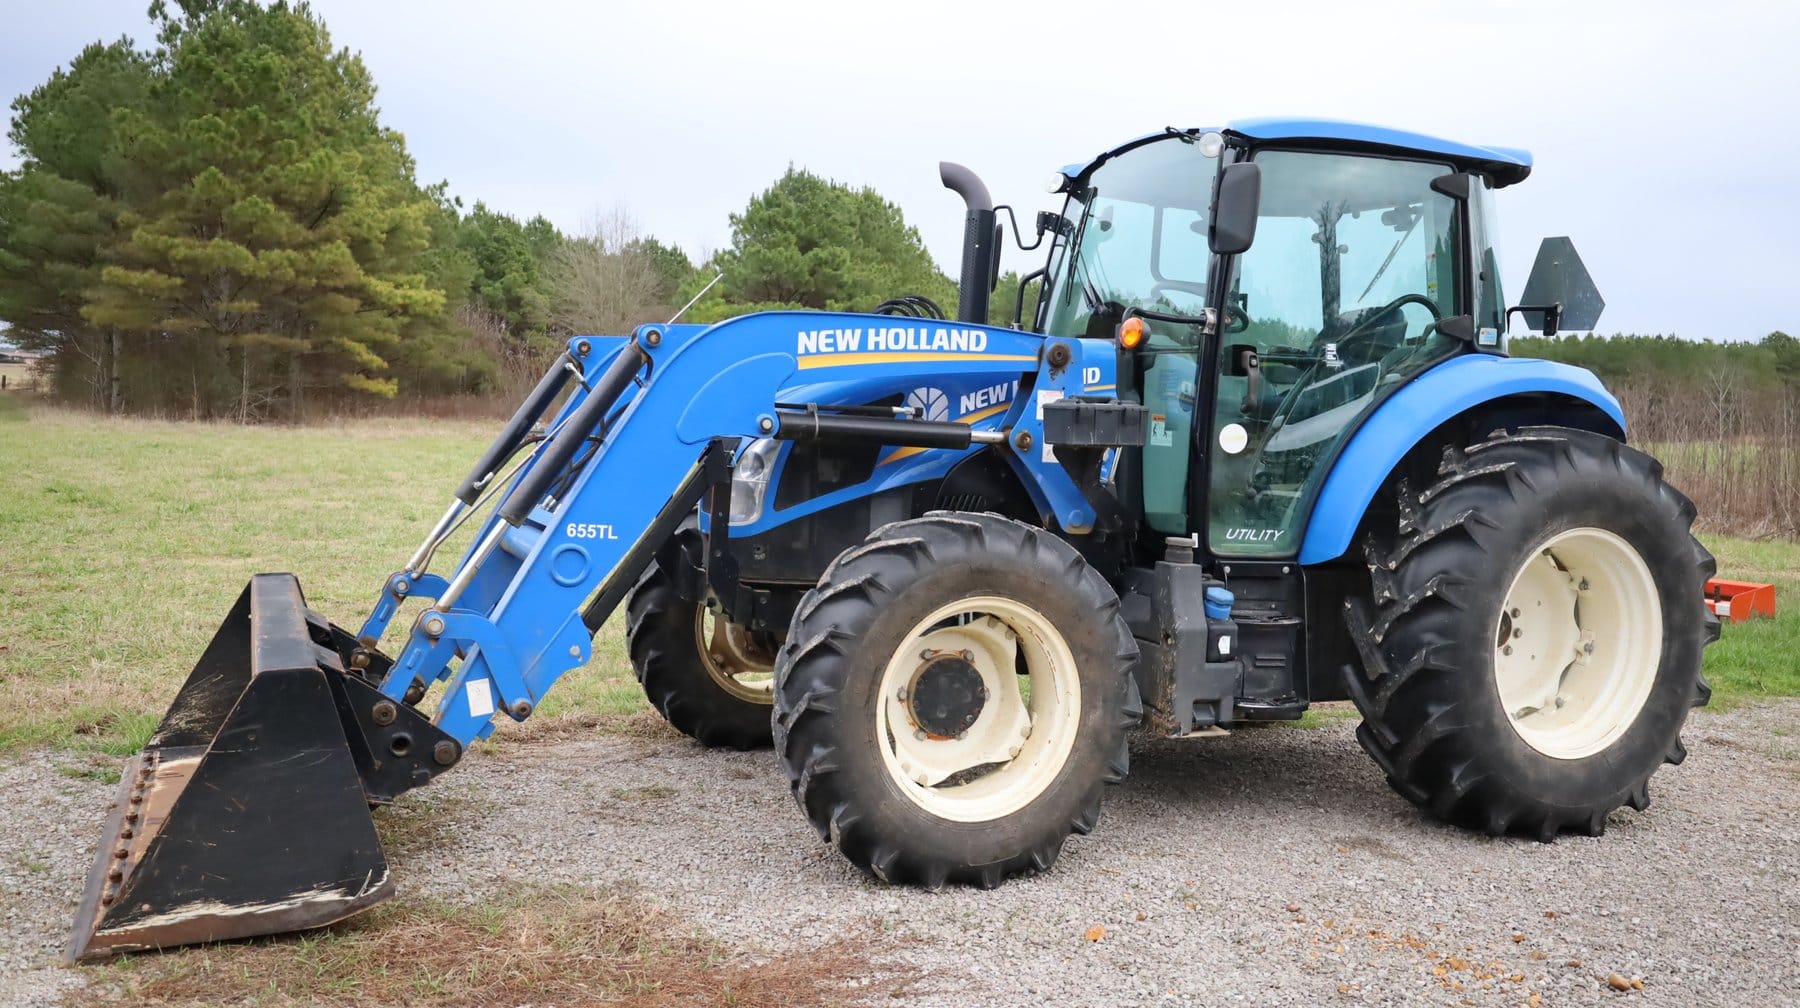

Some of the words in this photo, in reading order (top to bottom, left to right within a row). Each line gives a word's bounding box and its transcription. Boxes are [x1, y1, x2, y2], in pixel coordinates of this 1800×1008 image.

[798, 329, 862, 354] NEW
[867, 328, 988, 352] HOLLAND
[960, 382, 1009, 415] NEW
[566, 523, 618, 539] 655TL
[1225, 528, 1285, 541] UTILITY
